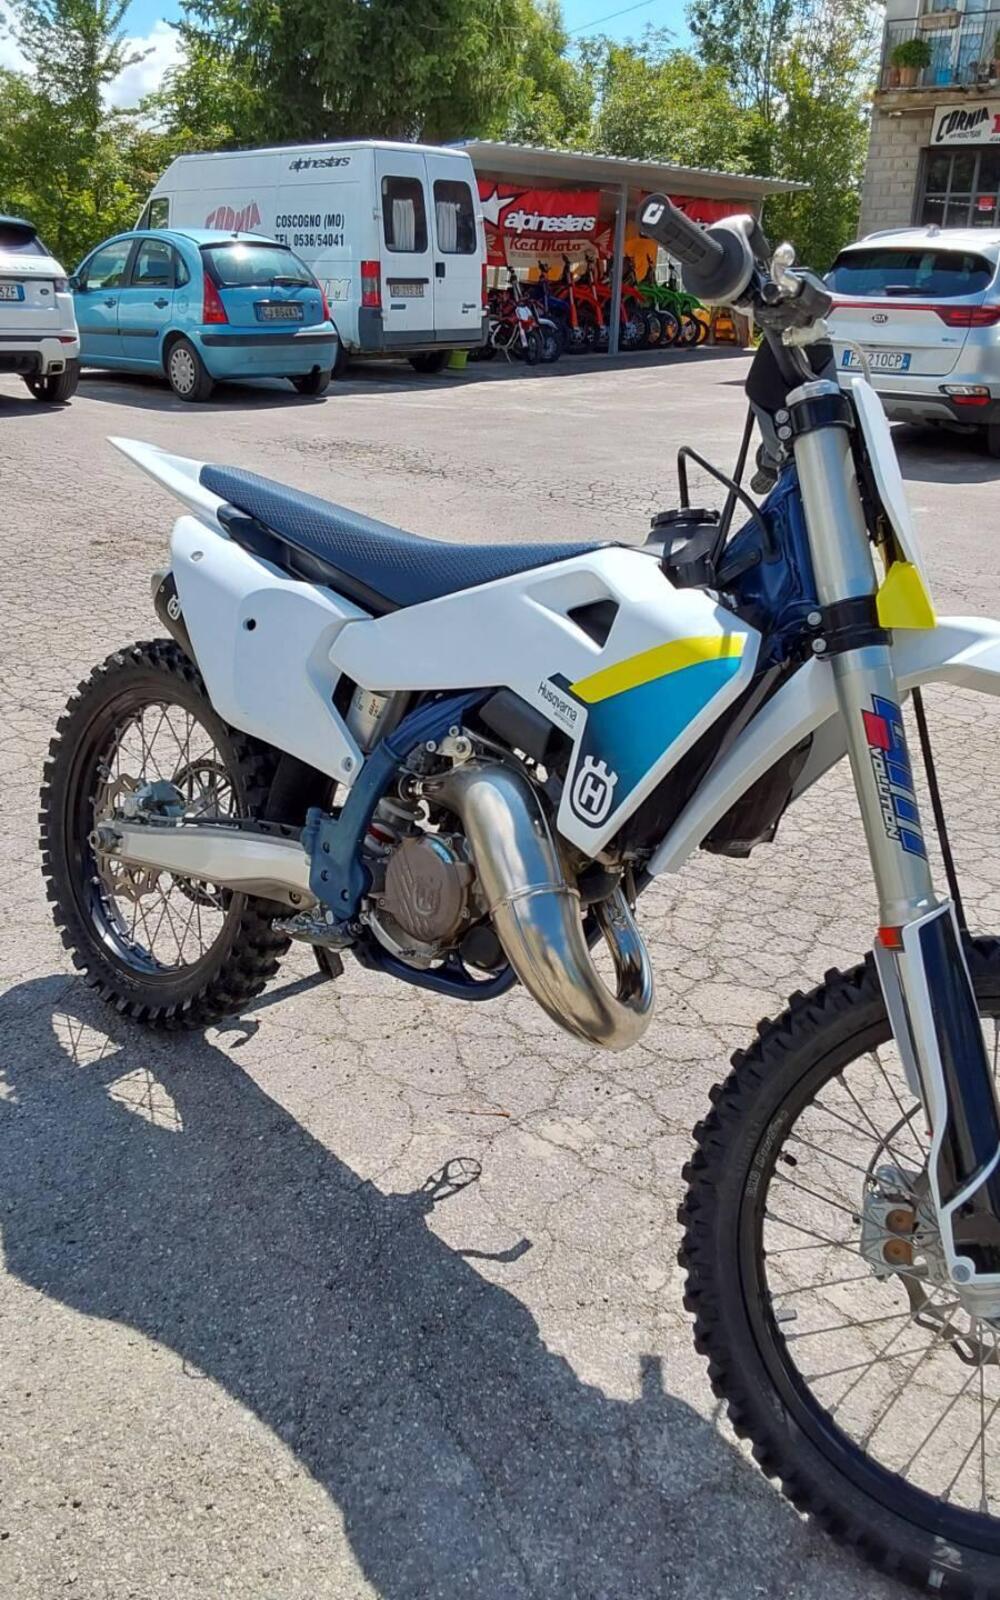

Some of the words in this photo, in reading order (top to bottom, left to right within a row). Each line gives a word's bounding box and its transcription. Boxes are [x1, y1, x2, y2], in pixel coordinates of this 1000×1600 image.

[936, 107, 989, 142] CORNIA
[288, 156, 350, 172] alpinestars
[275, 215, 321, 228] COSCOGNO
[323, 213, 345, 230] (MO)
[504, 210, 596, 233] alpinestars
[293, 234, 345, 247] 0536/54041
[537, 681, 577, 721] Husqvarna
